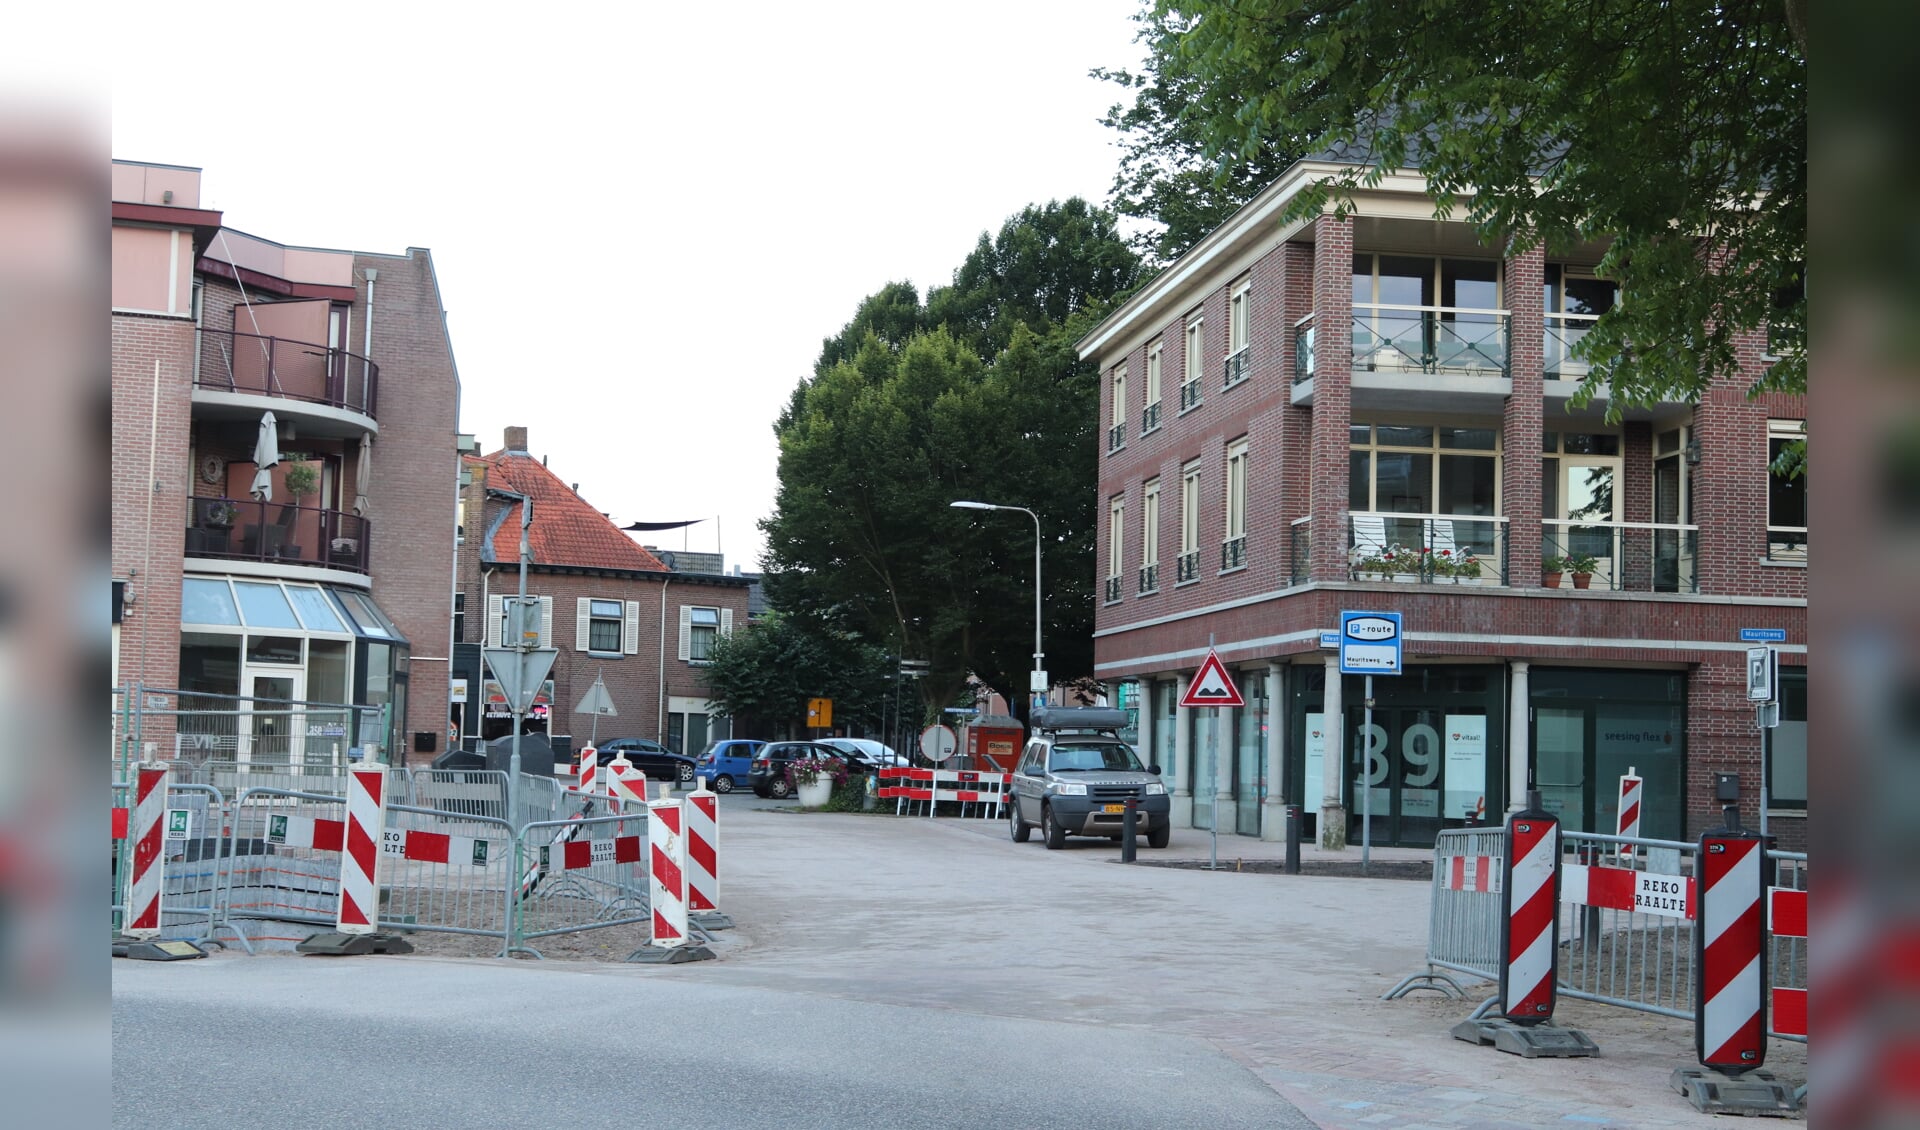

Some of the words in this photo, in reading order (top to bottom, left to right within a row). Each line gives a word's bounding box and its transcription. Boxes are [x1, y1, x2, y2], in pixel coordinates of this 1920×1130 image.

[1745, 630, 1782, 638] Mauritsweg
[1604, 730, 1641, 743] seesing
[1642, 731, 1661, 742] flex
[1356, 723, 1440, 787] 39
[384, 832, 400, 842] KO
[384, 844, 406, 854] LTE
[594, 843, 613, 852] REKO
[1643, 879, 1680, 894] REKO
[1635, 895, 1686, 912] RAALTE
